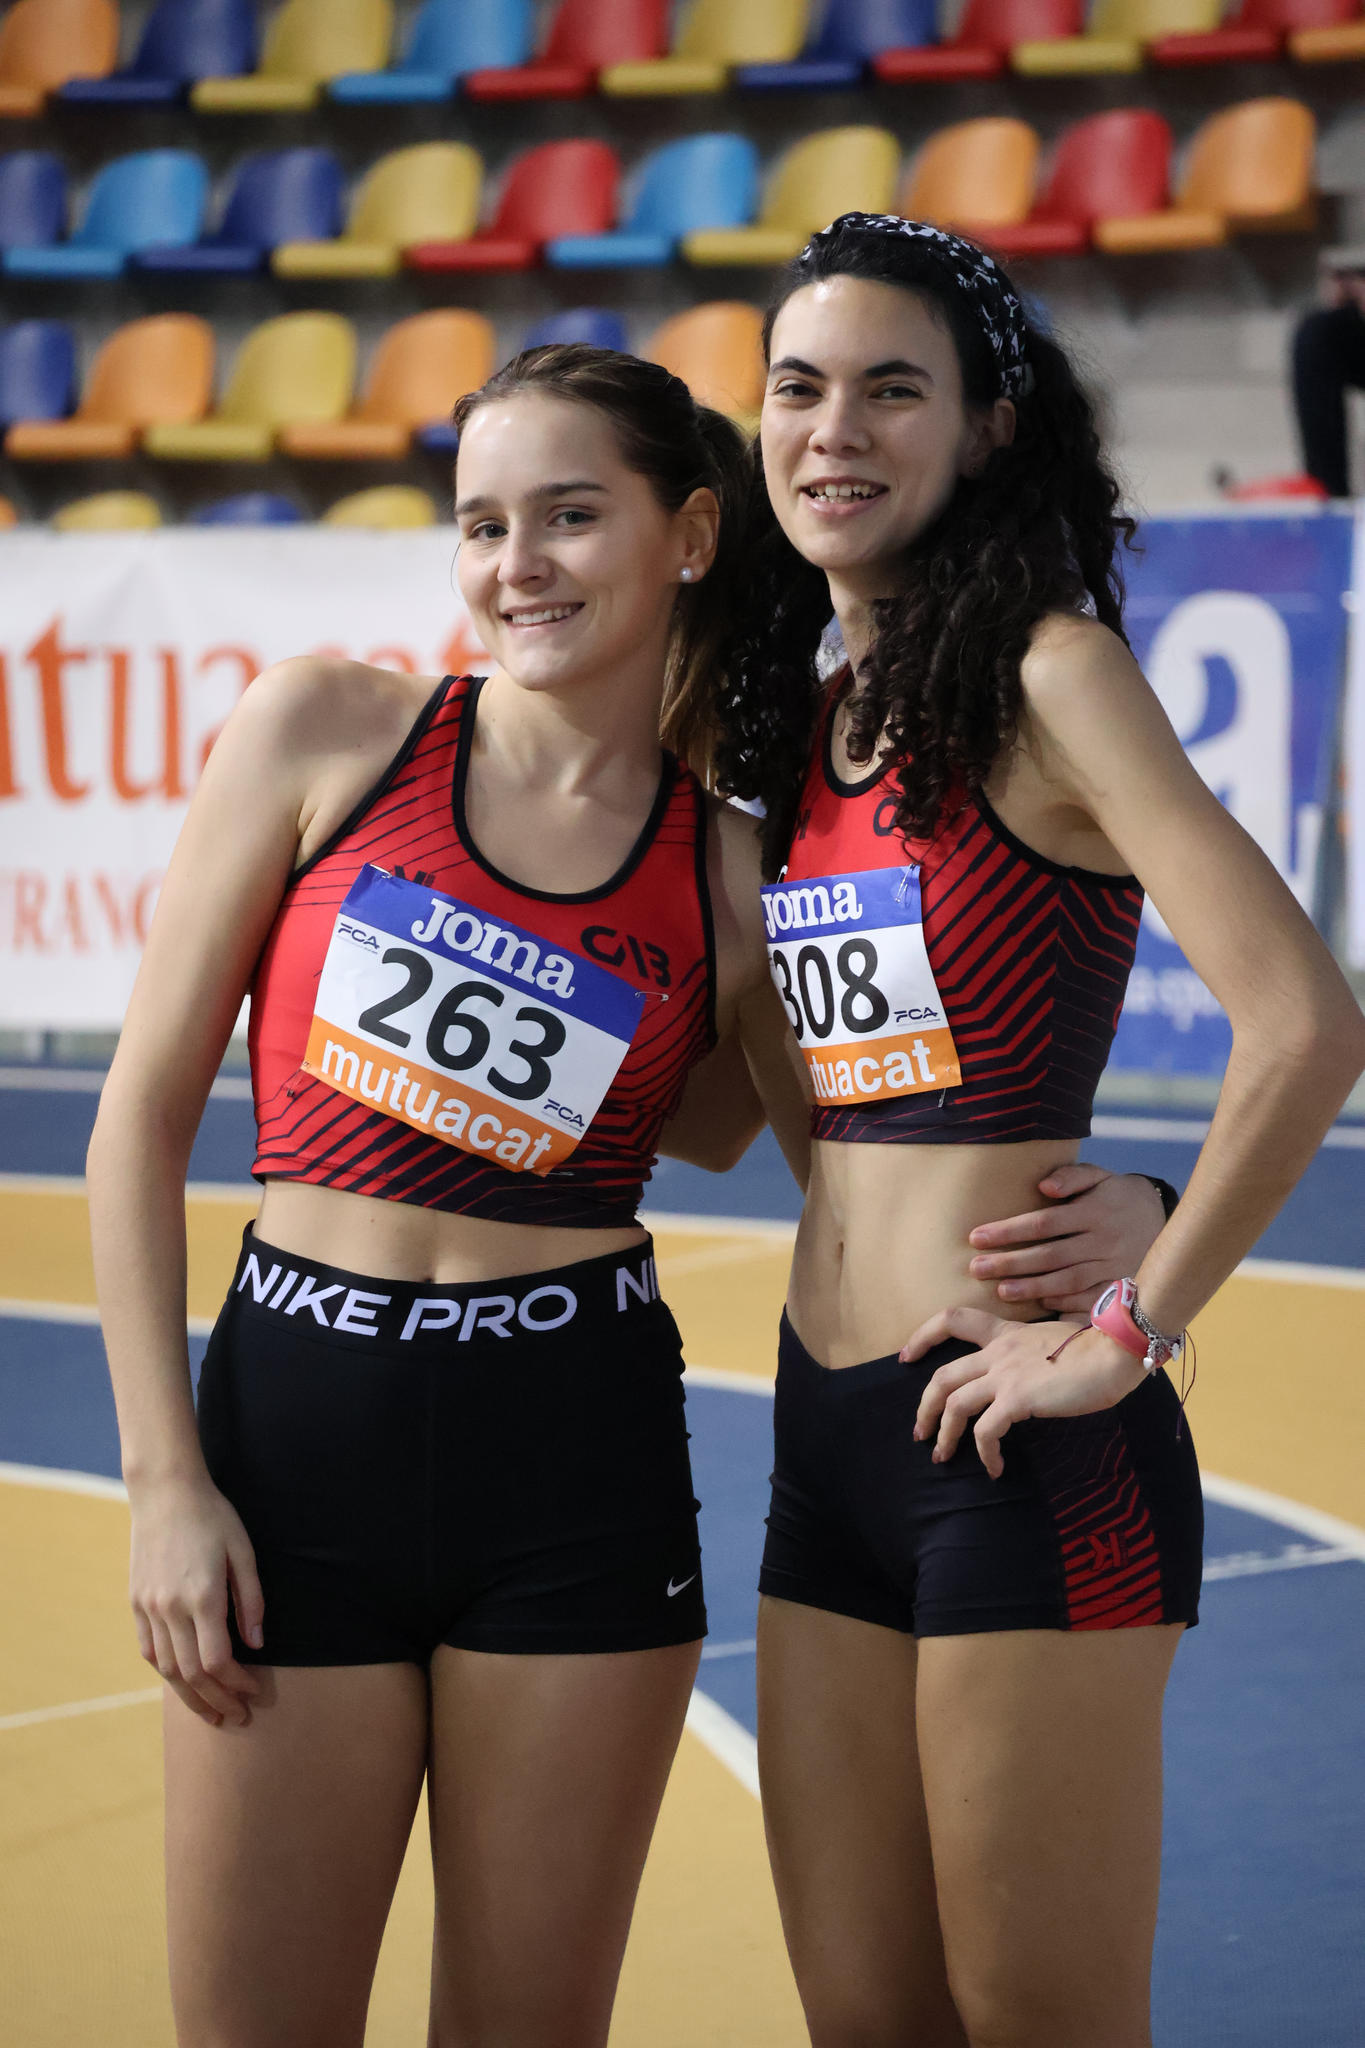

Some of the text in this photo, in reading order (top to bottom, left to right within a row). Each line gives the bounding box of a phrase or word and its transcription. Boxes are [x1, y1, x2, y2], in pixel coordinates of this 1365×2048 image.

[337, 922, 380, 950] FCA
[357, 947, 567, 1101] 263
[773, 937, 889, 1041] 308
[893, 1006, 938, 1023] FCA
[321, 1038, 553, 1171] mutuacat
[810, 1038, 937, 1098] tuacat
[543, 1098, 585, 1128] FCA
[236, 1252, 660, 1342] NIKE PRO NI
